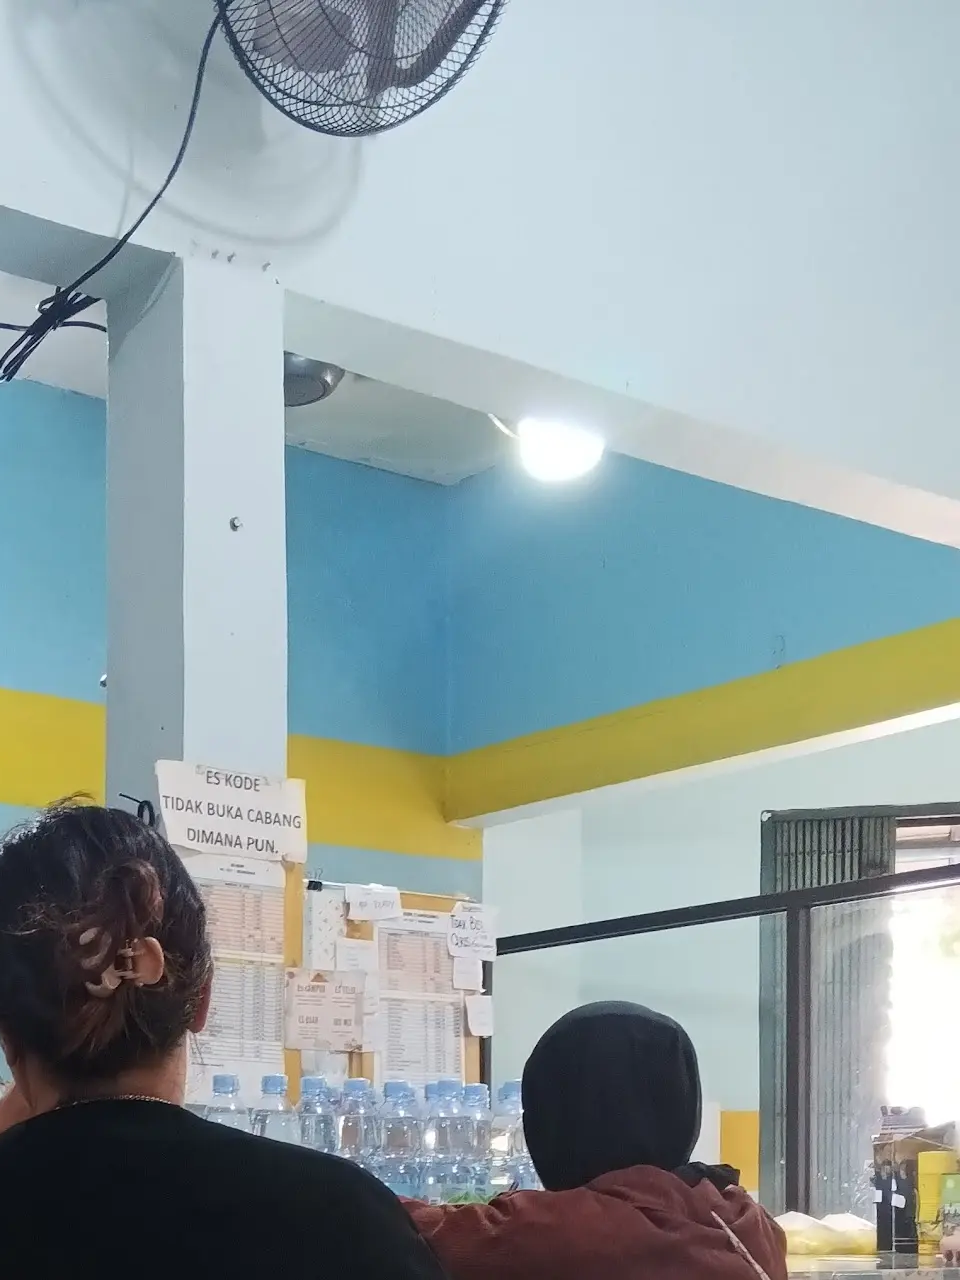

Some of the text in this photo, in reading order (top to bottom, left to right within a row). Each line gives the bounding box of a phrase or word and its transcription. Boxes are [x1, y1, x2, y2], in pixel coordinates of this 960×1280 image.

[206, 770, 261, 792] ES KODE
[162, 795, 302, 829] TIDAK BUKA CABANG
[187, 828, 279, 854] DIMANA PUN.
